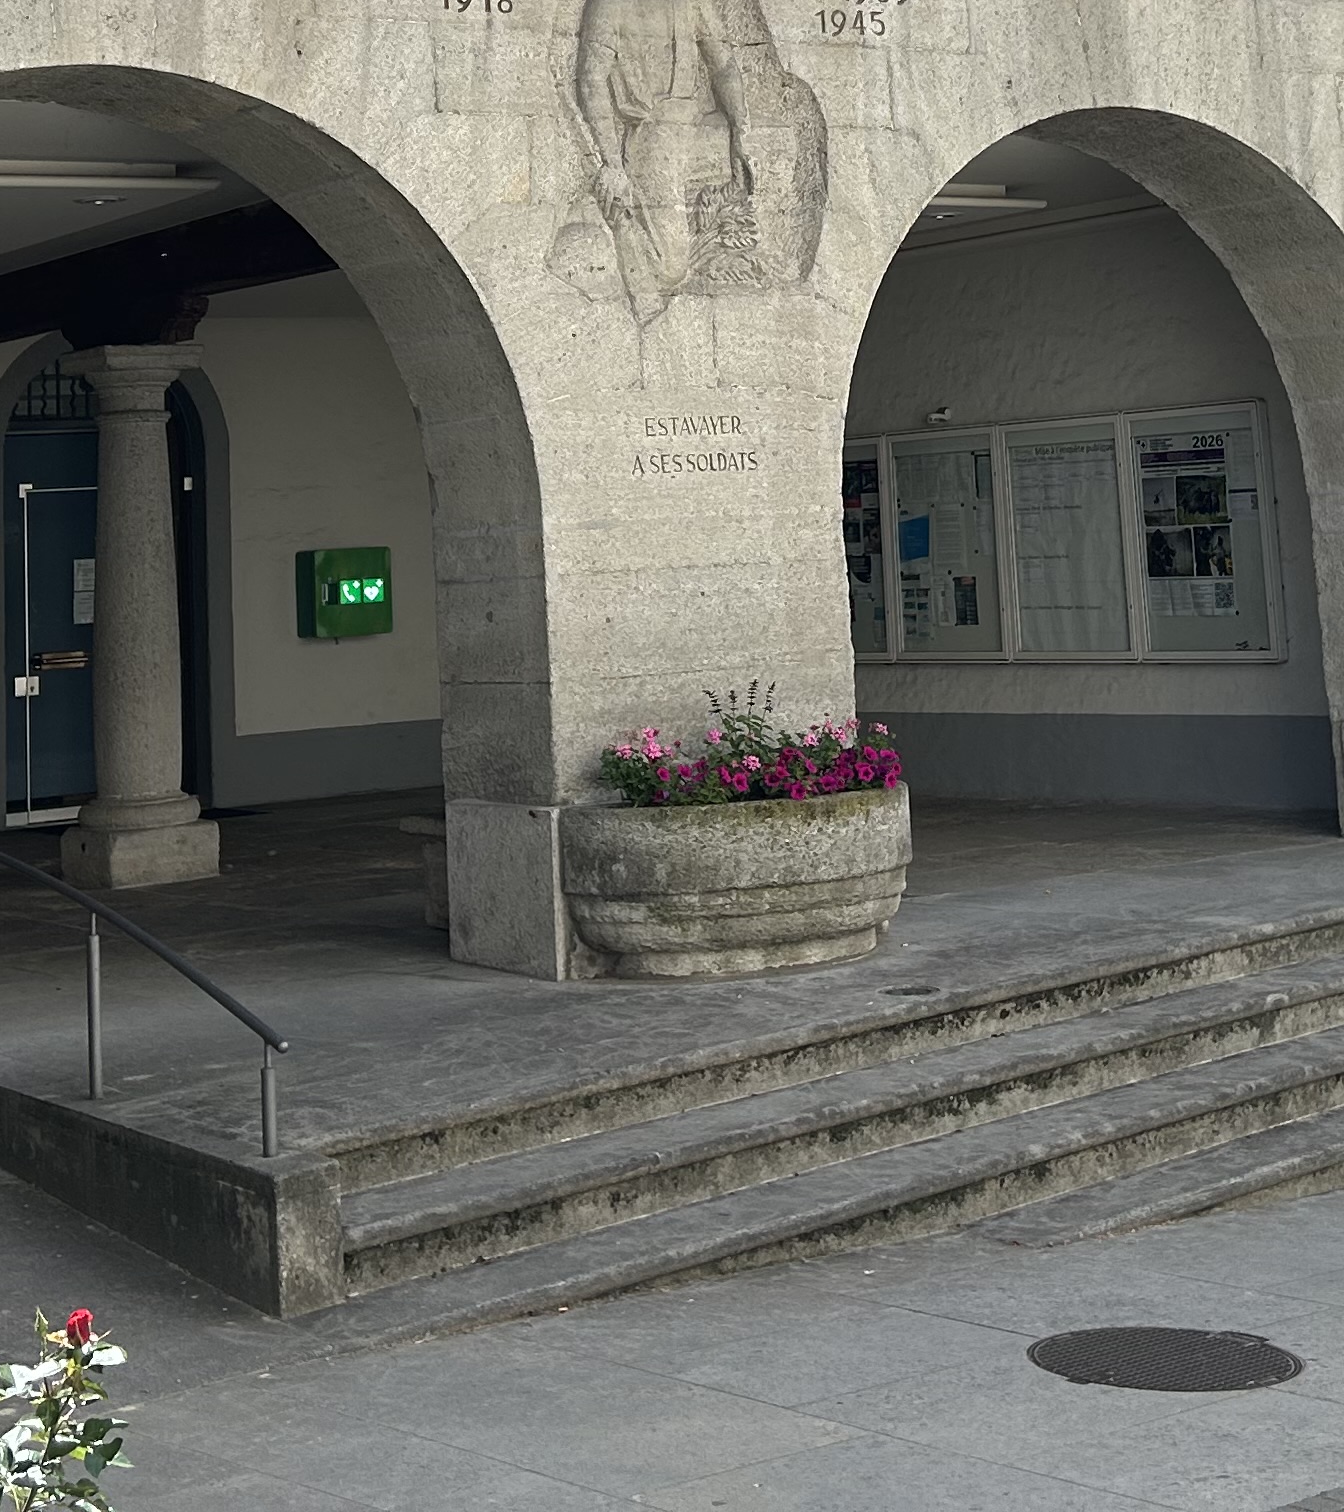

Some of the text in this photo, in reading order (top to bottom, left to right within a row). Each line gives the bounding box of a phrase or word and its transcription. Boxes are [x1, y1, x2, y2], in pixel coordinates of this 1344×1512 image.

[814, 9, 886, 37] 1945
[644, 414, 742, 437] ESTAVAYER
[1192, 434, 1223, 448] 2026
[631, 451, 758, 476] A SES SOLDATS
